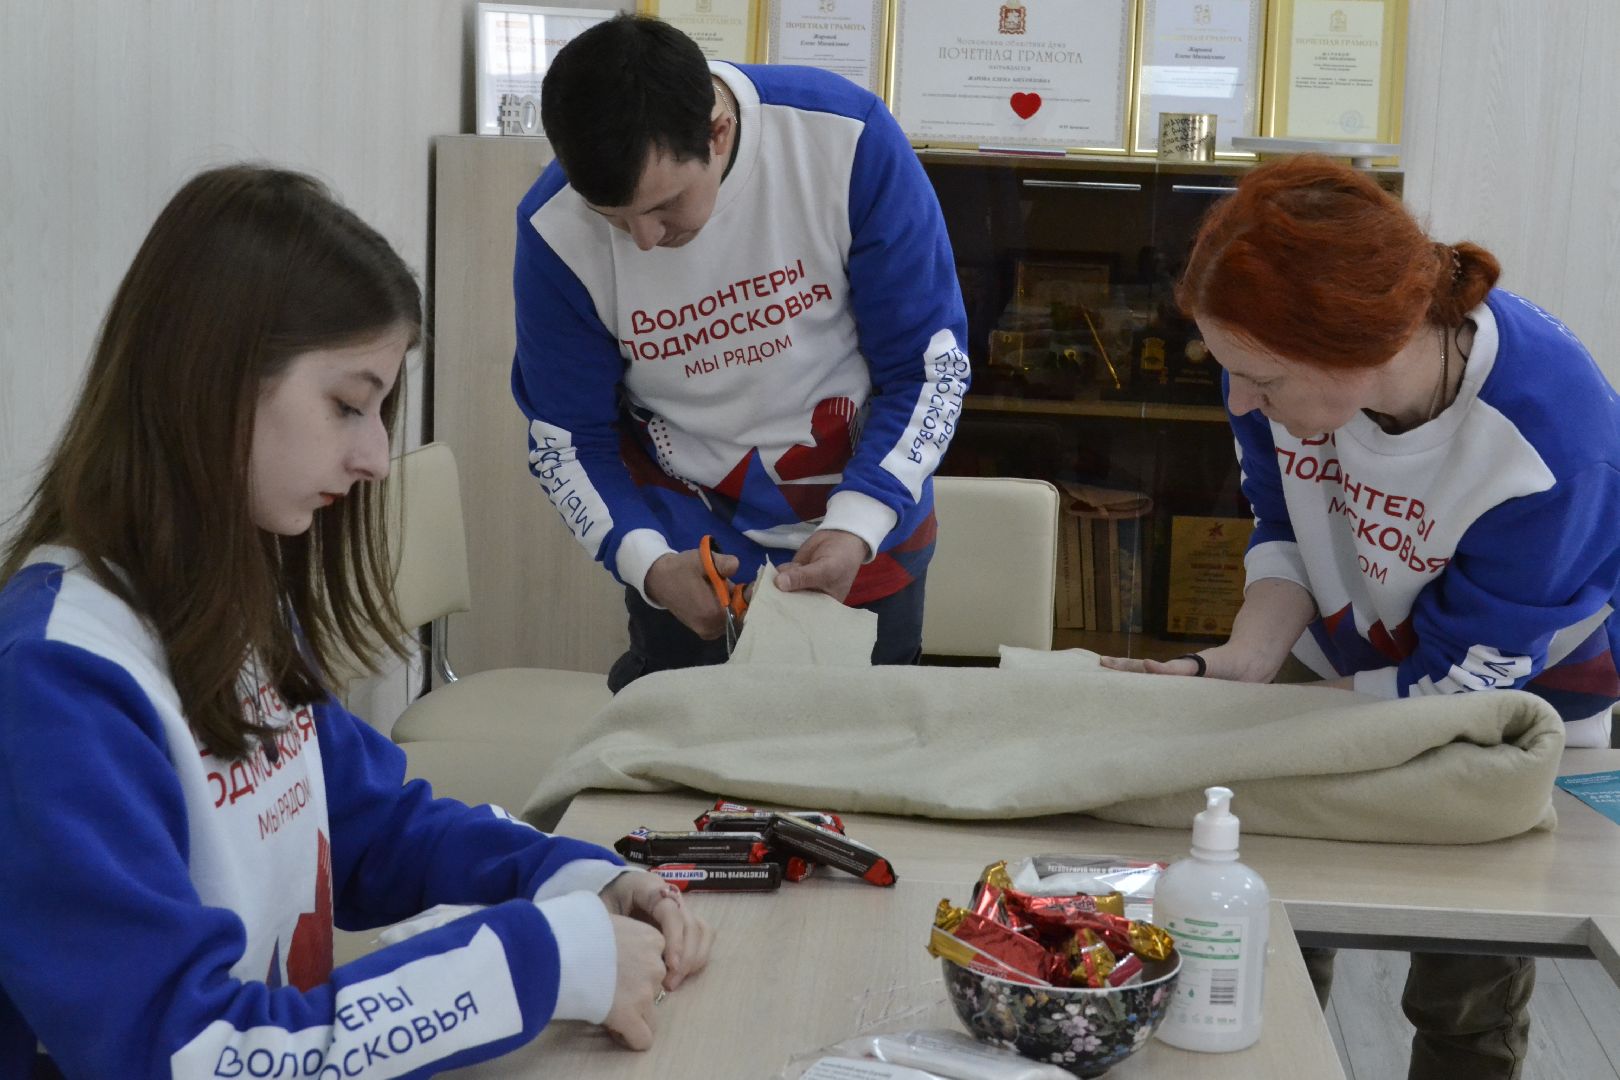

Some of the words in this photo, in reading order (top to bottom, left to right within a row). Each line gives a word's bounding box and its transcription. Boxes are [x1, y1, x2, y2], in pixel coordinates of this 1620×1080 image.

[938, 46, 1013, 61] ПОЧЕТНАЯ
[1018, 50, 1084, 65] ГРАМОТА
[631, 259, 805, 335] ВОЛОНТЕРЫ
[684, 354, 720, 378] МЫ
[723, 335, 793, 368] РЯДОМ
[559, 489, 595, 538] МЫ
